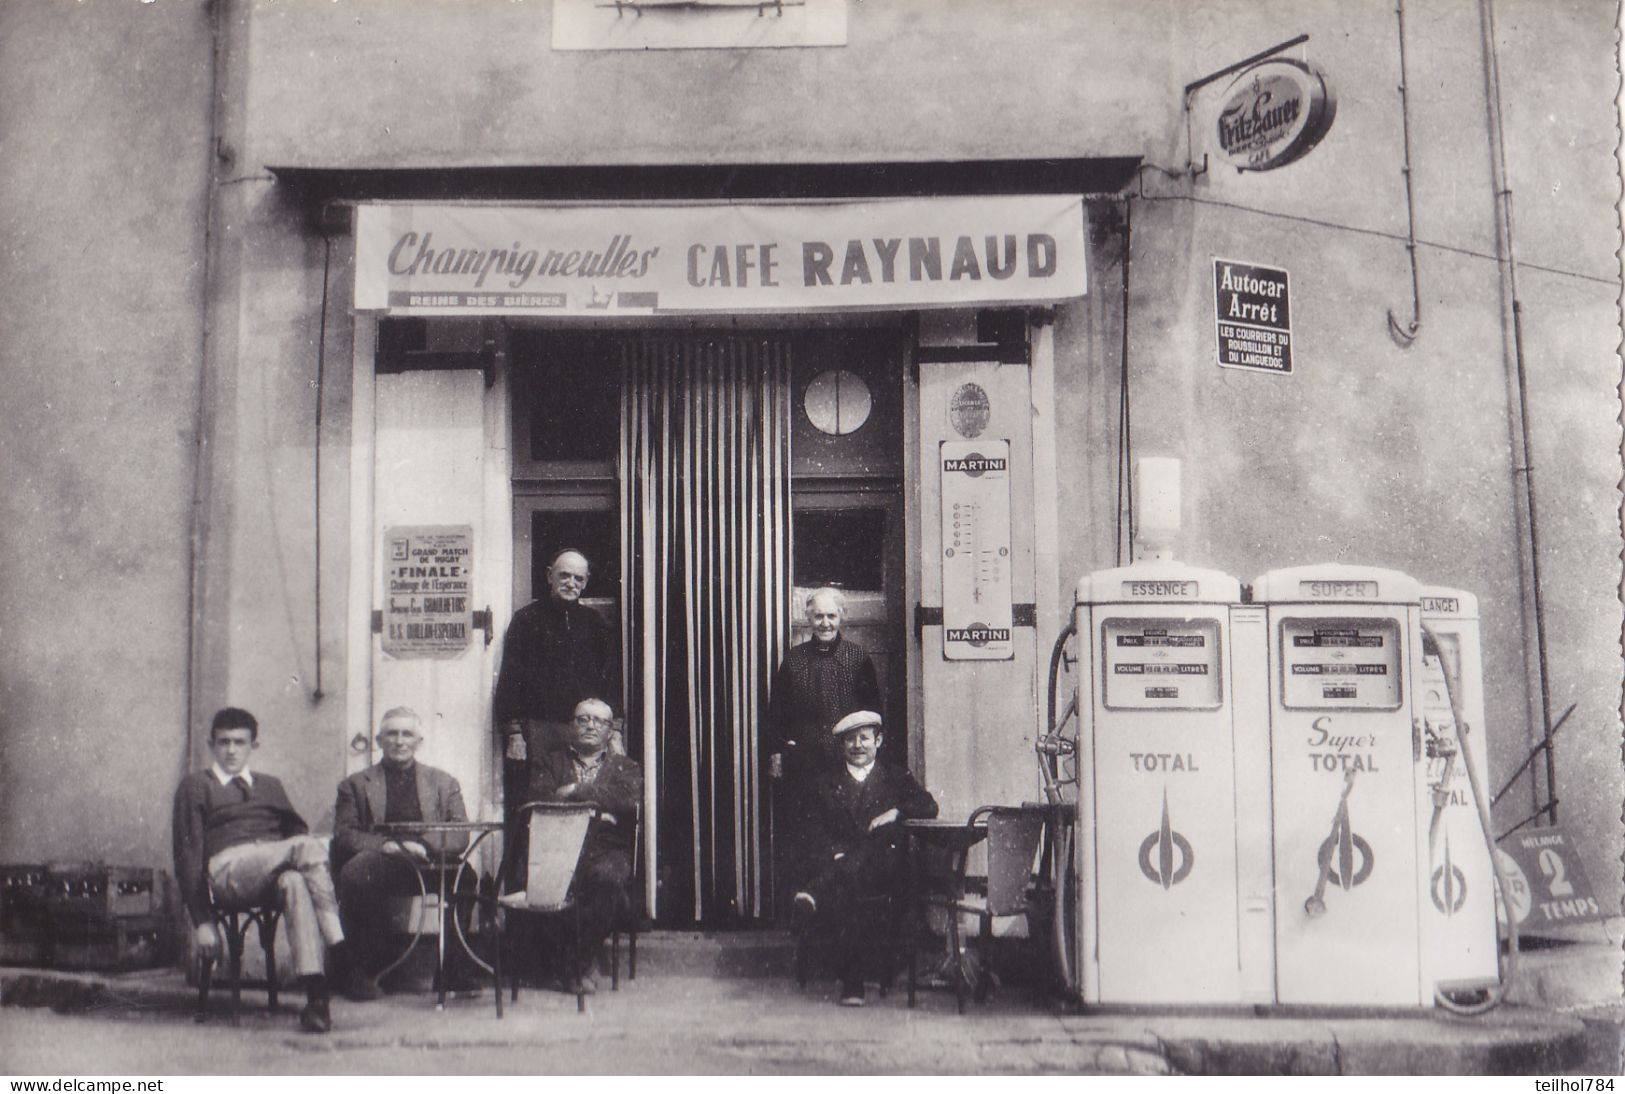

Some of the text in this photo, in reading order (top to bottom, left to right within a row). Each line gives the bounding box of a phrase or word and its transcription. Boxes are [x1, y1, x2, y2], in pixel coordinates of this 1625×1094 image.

[387, 231, 1057, 289] Champigneulles CAFE RAYNAUD
[1221, 266, 1285, 298] Autocar
[410, 295, 459, 306] REINE
[467, 296, 497, 306] DES
[1229, 293, 1277, 322] Arrêt
[1221, 326, 1288, 346] LES COURRIERS DU
[1229, 340, 1282, 356] ROUSSILLON ET
[1229, 352, 1283, 368] DU LANGUEDOC
[946, 460, 1004, 470] MARTINI
[399, 567, 460, 578] FINALE
[1132, 583, 1188, 596] ESSENCE
[1311, 583, 1366, 597] SUPER
[1422, 600, 1454, 613] LANGE
[949, 630, 1007, 640] MARTINI
[1117, 665, 1142, 673] VOLUME
[1294, 665, 1320, 673] VOLUME
[1360, 665, 1384, 673] LITRES
[1308, 715, 1375, 752] Super
[1130, 753, 1199, 772] TOTAL
[1308, 754, 1379, 773] TOTAL
[1539, 848, 1573, 897] 2
[1540, 897, 1599, 920] TEMPS
